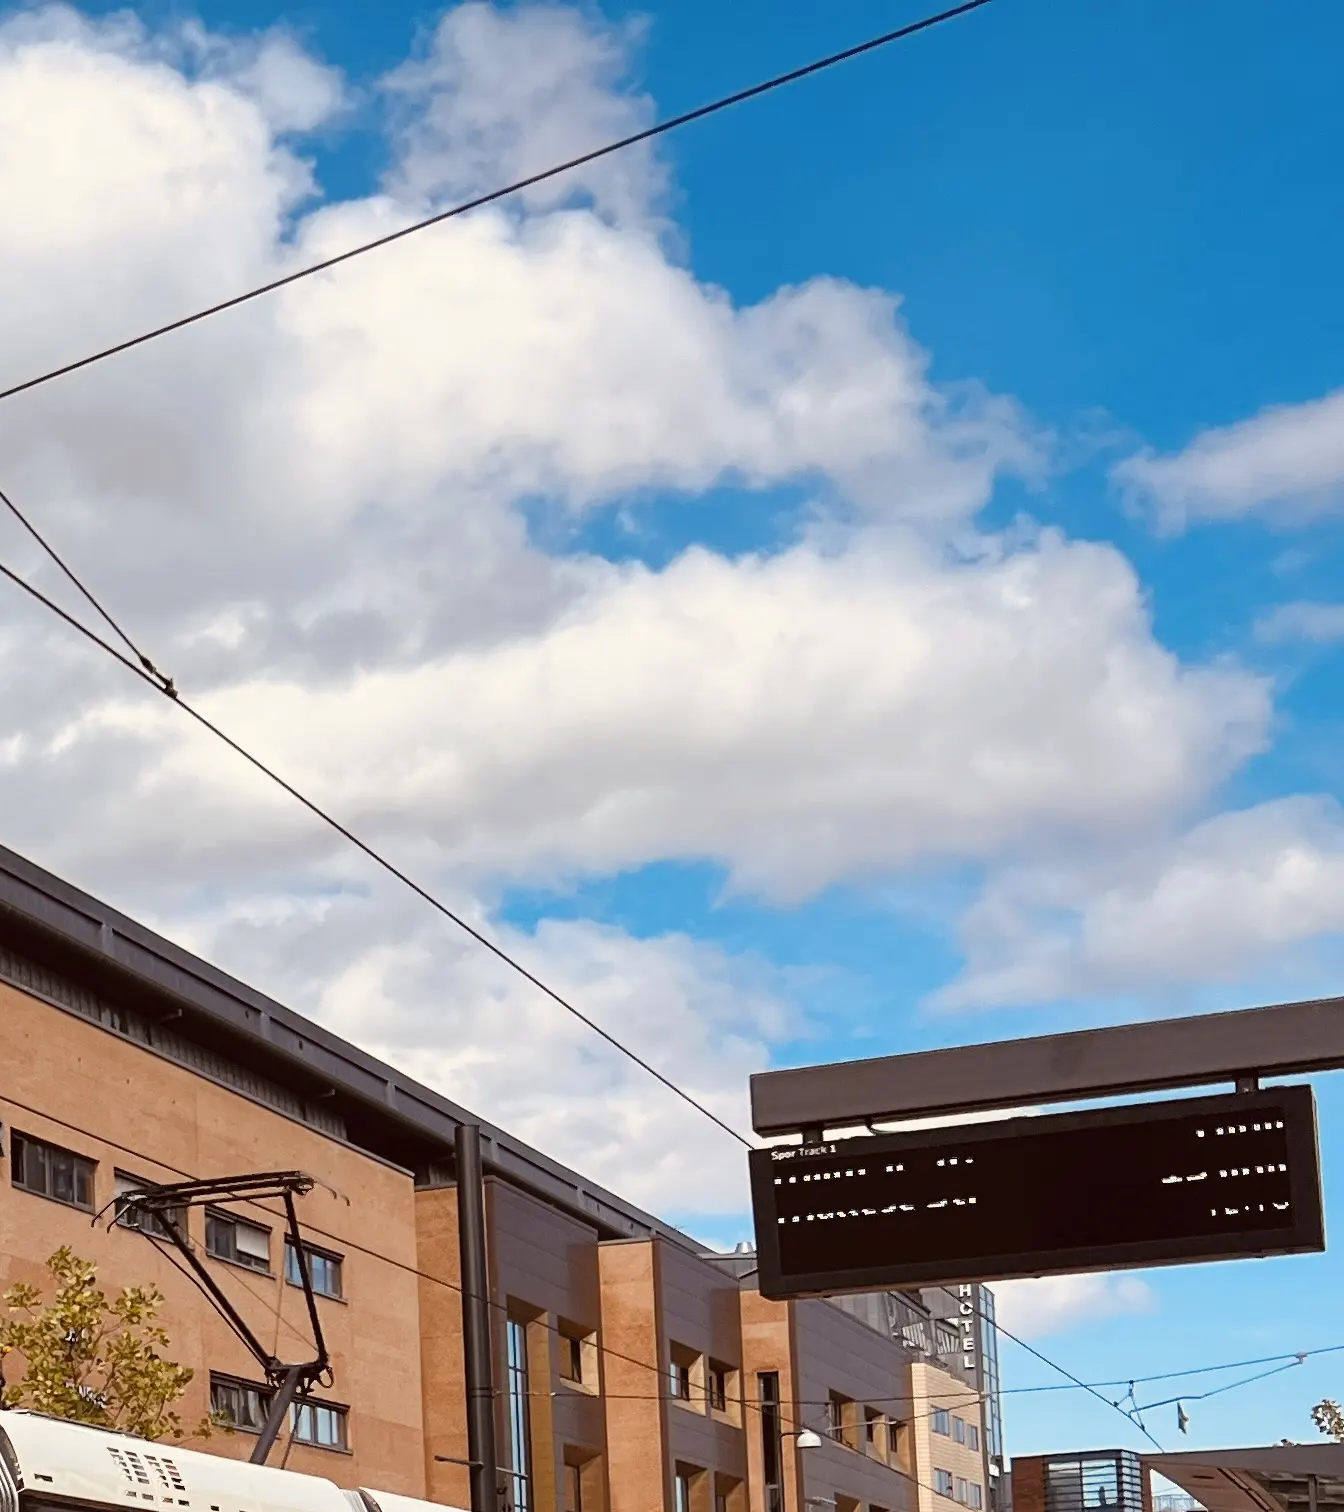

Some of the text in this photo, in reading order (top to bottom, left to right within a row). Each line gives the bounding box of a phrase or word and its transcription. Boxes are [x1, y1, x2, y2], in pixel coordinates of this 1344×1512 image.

[771, 1144, 836, 1161] Spor Track 1
[959, 1283, 975, 1369] HOTEL
